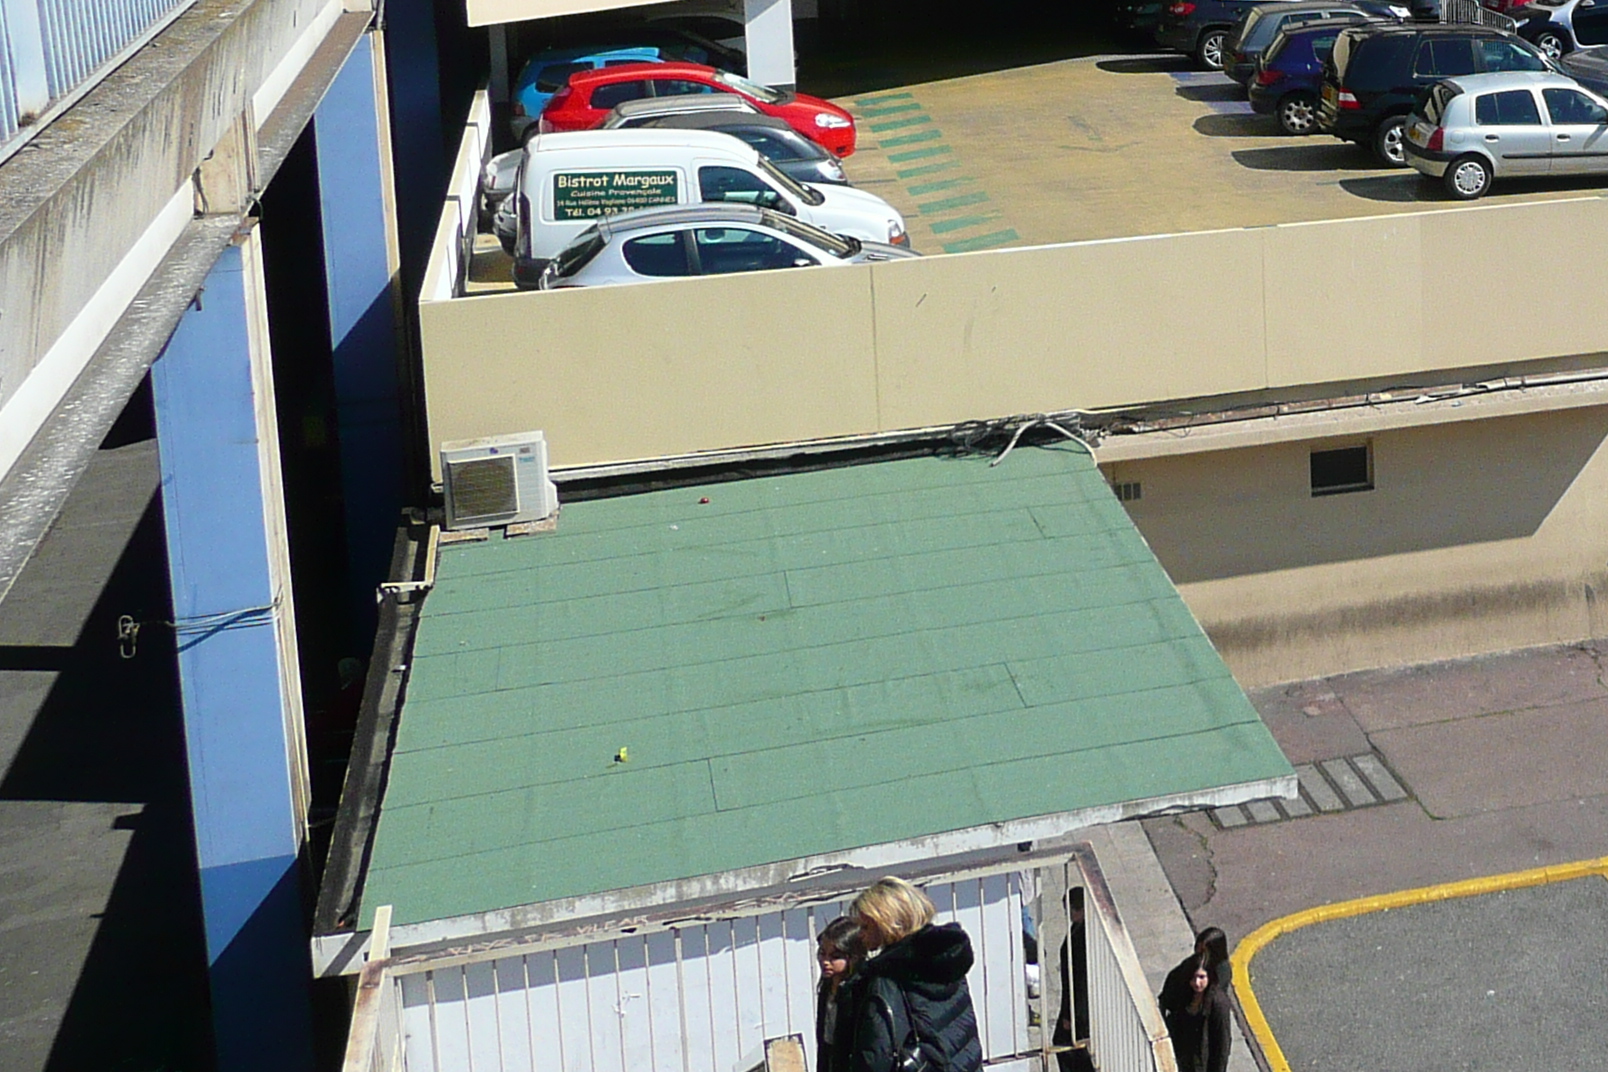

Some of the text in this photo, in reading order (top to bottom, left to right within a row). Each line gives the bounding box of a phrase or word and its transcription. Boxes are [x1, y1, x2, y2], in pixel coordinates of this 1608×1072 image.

[558, 174, 674, 188] Bistrot Margaux
[570, 190, 606, 198] Cuisine
[648, 196, 676, 204] CANNES
[565, 208, 585, 217] Tél.
[587, 208, 601, 216] 04
